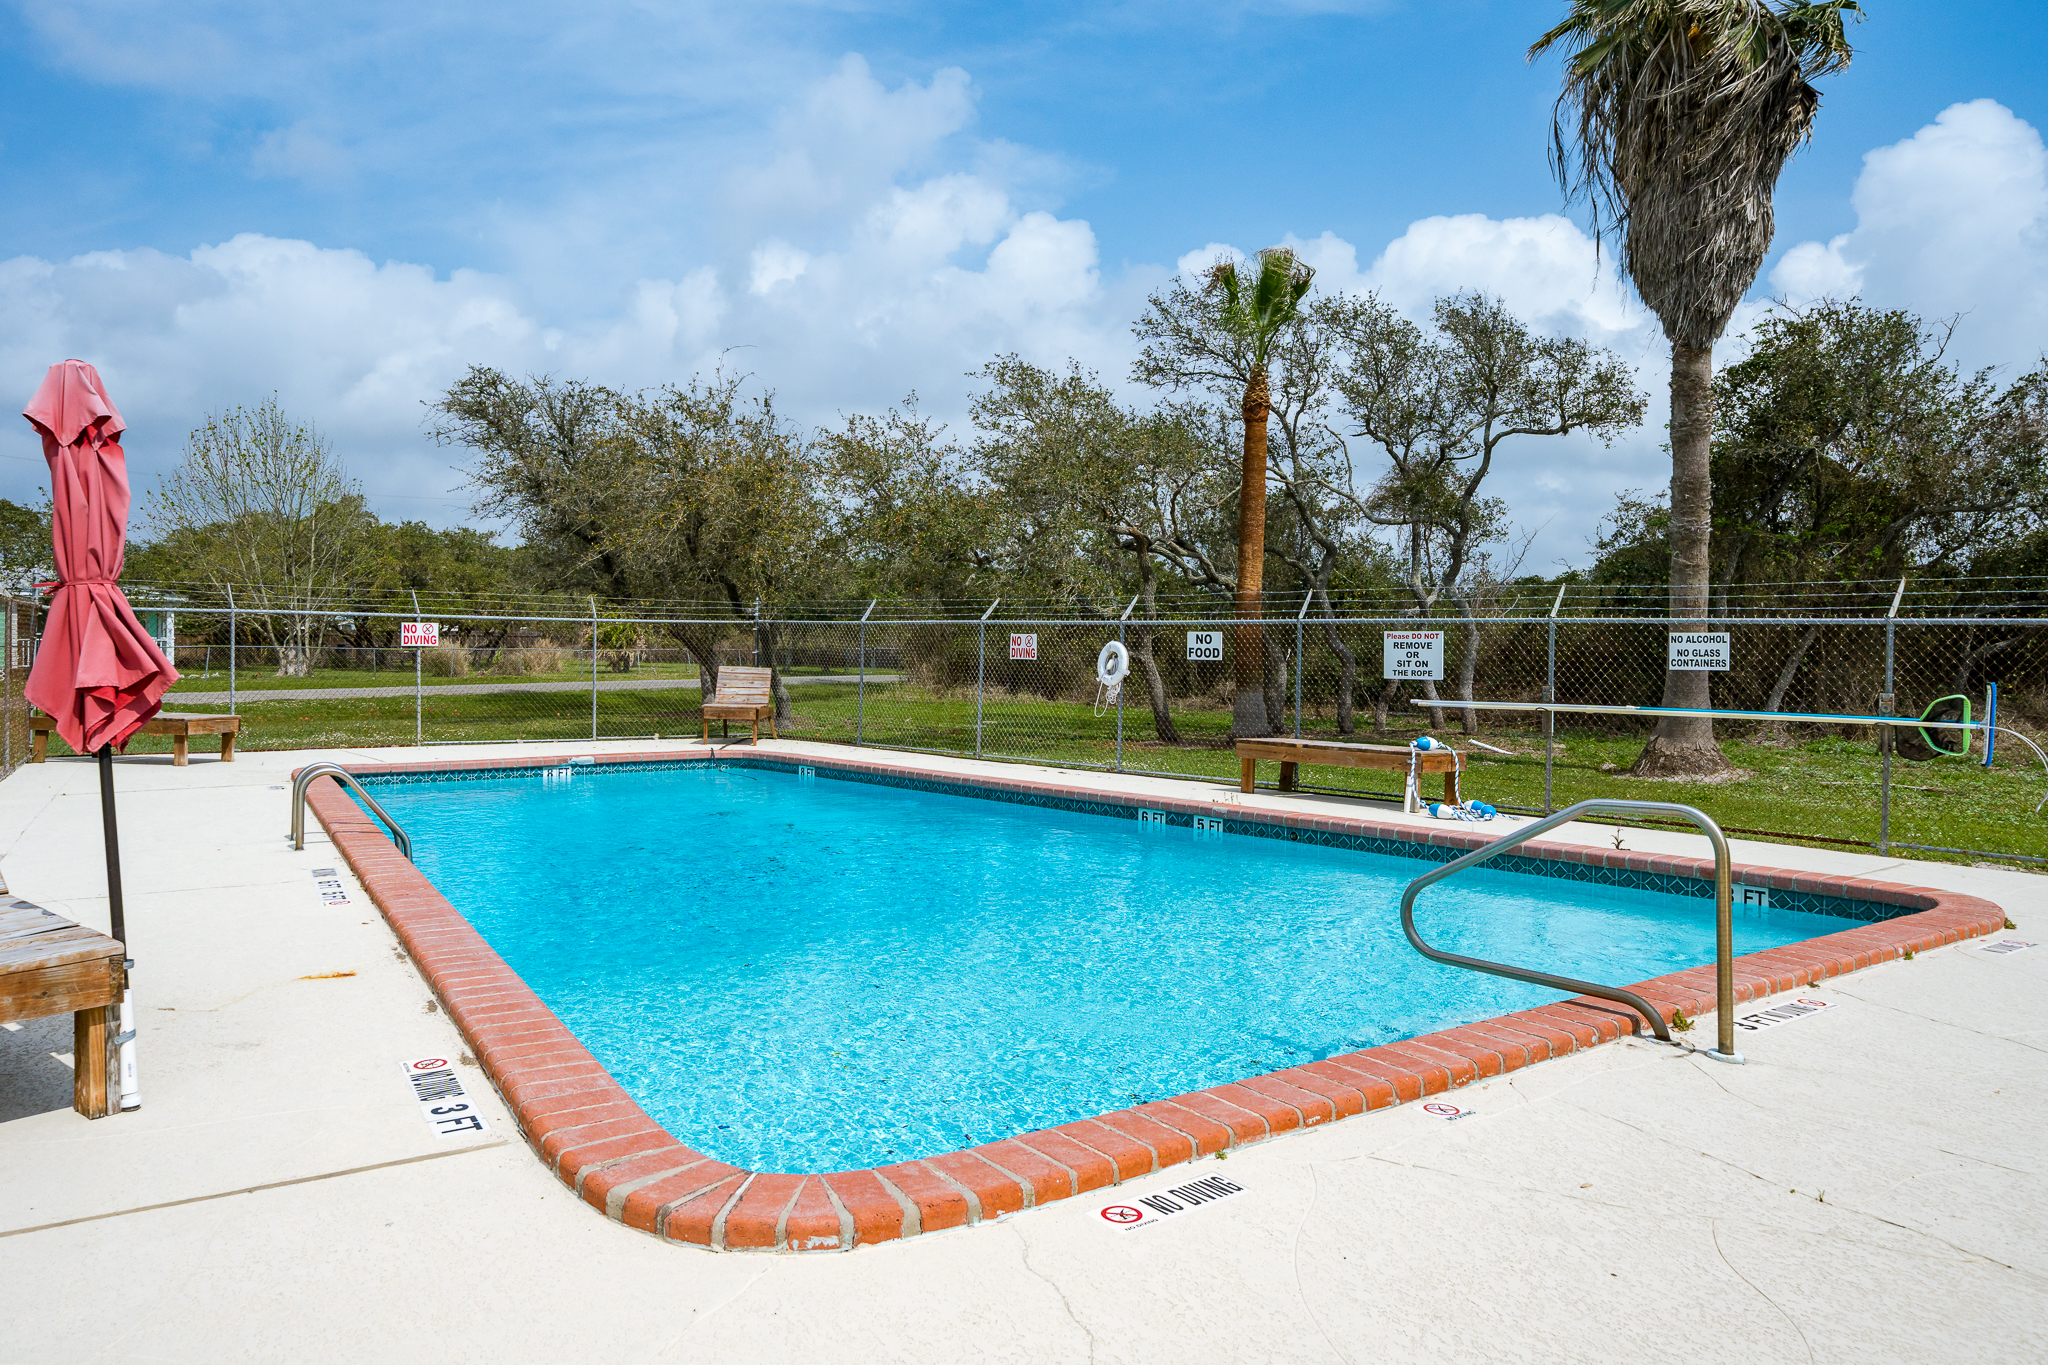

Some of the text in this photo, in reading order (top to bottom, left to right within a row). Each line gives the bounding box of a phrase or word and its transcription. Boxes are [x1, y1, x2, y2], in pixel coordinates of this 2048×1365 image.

[403, 624, 417, 634] NO
[403, 635, 437, 645] DIVING
[1011, 636, 1022, 647] NO
[1196, 634, 1213, 645] NO
[1671, 635, 1727, 643] NO ALCOHOL
[1393, 642, 1433, 650] REMOVE
[1011, 647, 1036, 659] DIVING
[1188, 647, 1220, 659] FOOD
[1406, 651, 1420, 659] OR
[1677, 648, 1721, 657] NO GLASS
[1396, 660, 1429, 668] SIT ON
[1671, 658, 1727, 667] CONTAINERS
[558, 767, 570, 777] FT
[1141, 811, 1165, 824] 6 FT
[1197, 818, 1222, 832] 5 FT
[1743, 888, 1766, 907] FT
[430, 1103, 470, 1115] 3
[436, 1115, 484, 1135] FT
[1138, 1176, 1244, 1216] NO DIVING
